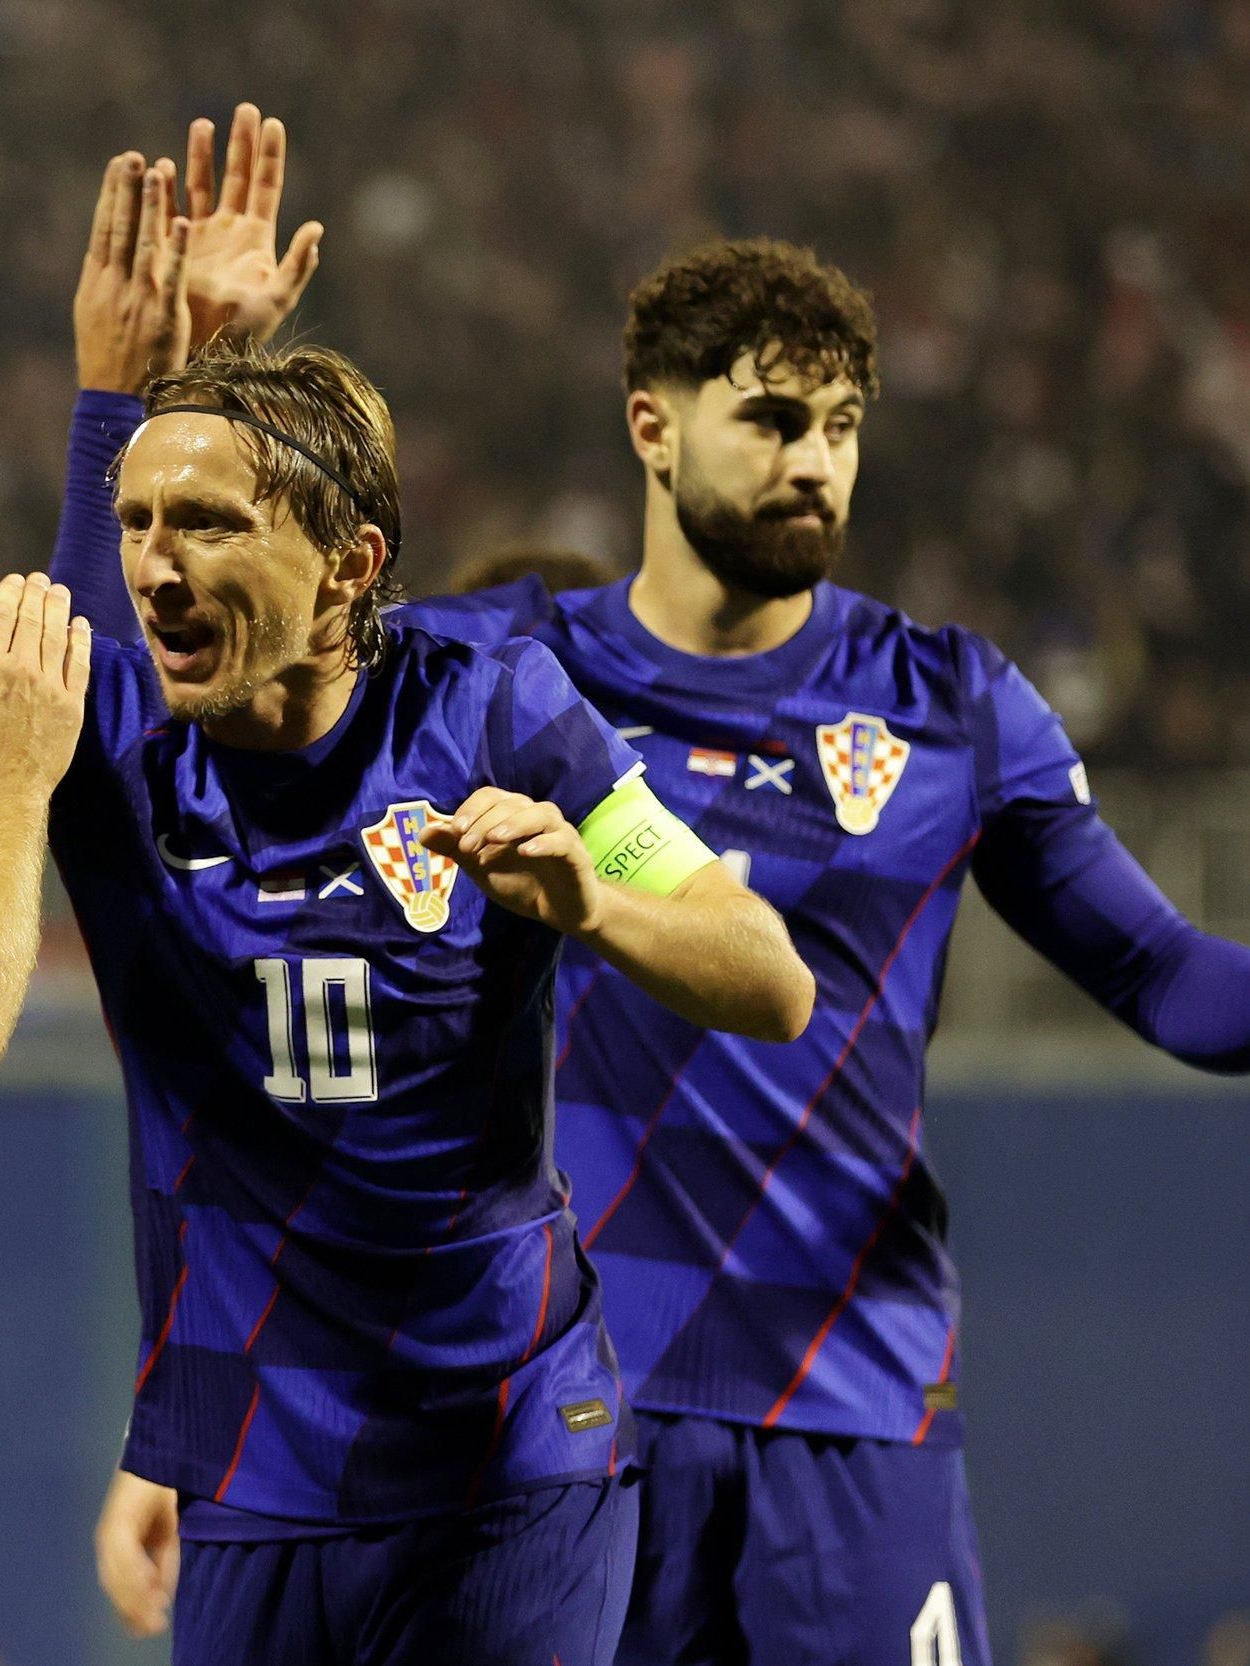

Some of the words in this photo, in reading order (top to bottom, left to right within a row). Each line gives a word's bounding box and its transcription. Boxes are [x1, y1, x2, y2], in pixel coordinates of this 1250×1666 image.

[403, 817, 426, 880] HNS
[599, 825, 661, 881] SPECT
[254, 958, 378, 1103] 10
